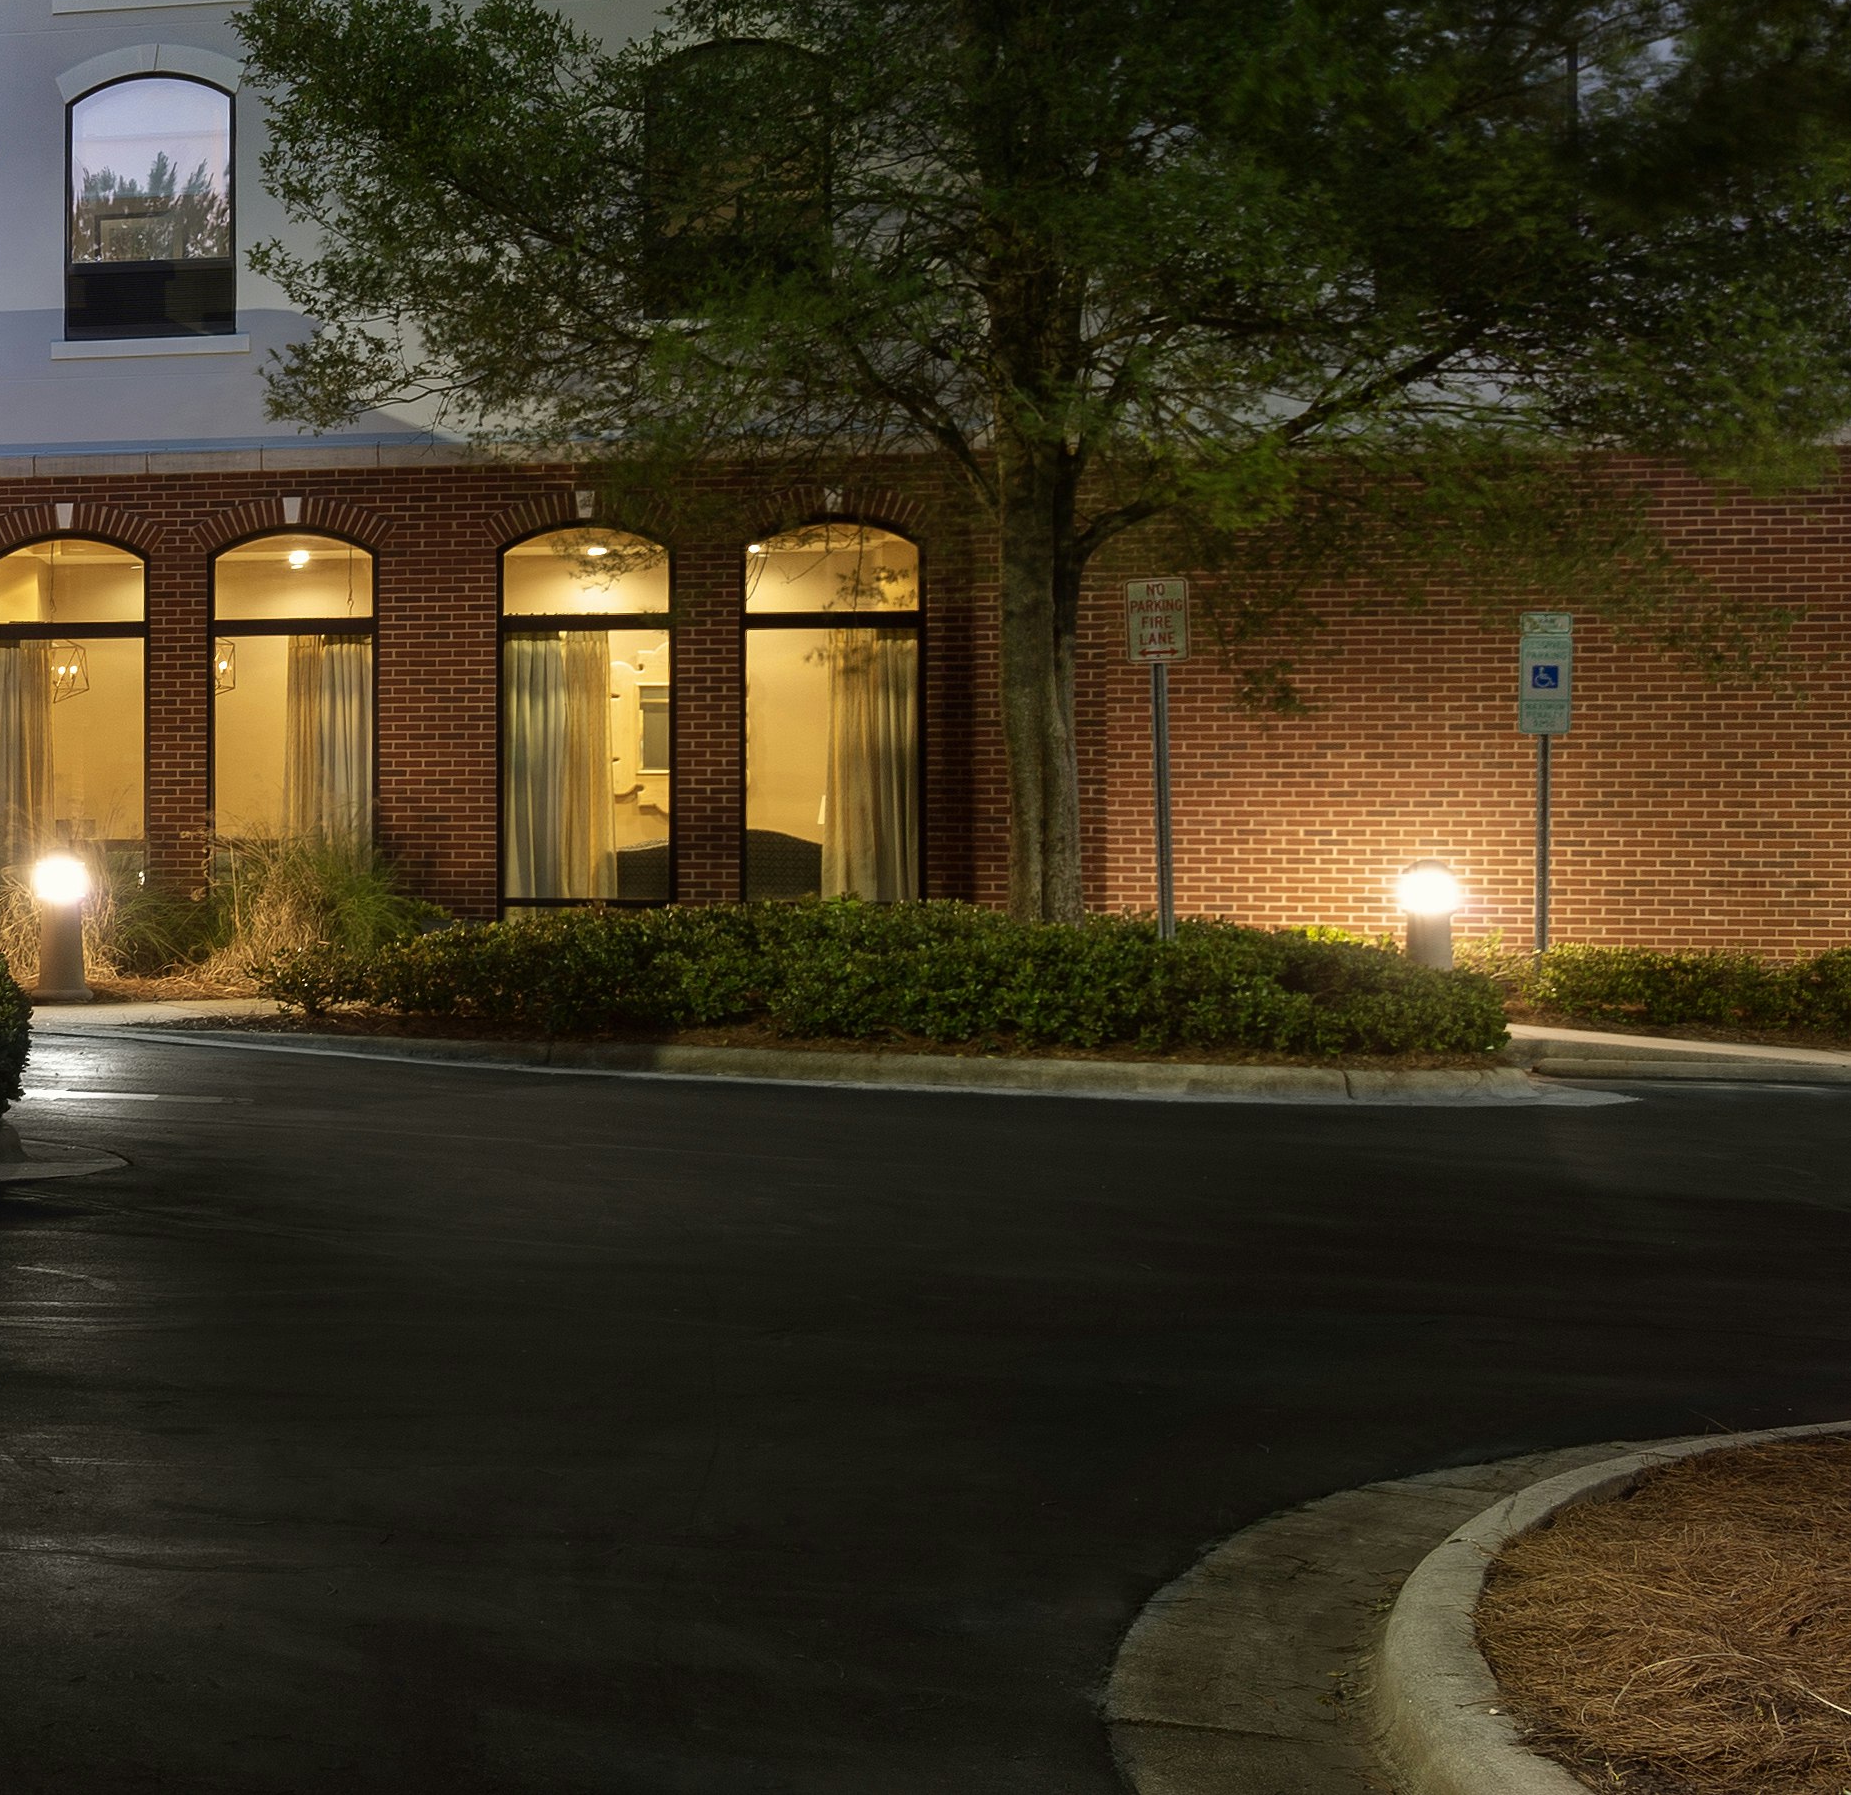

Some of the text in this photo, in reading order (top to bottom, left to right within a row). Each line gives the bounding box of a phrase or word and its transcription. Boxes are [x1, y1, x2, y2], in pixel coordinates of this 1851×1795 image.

[1146, 583, 1165, 596] NO
[1130, 598, 1183, 614] PARKING
[1141, 615, 1173, 629] FIRE
[1139, 631, 1176, 645] LANE
